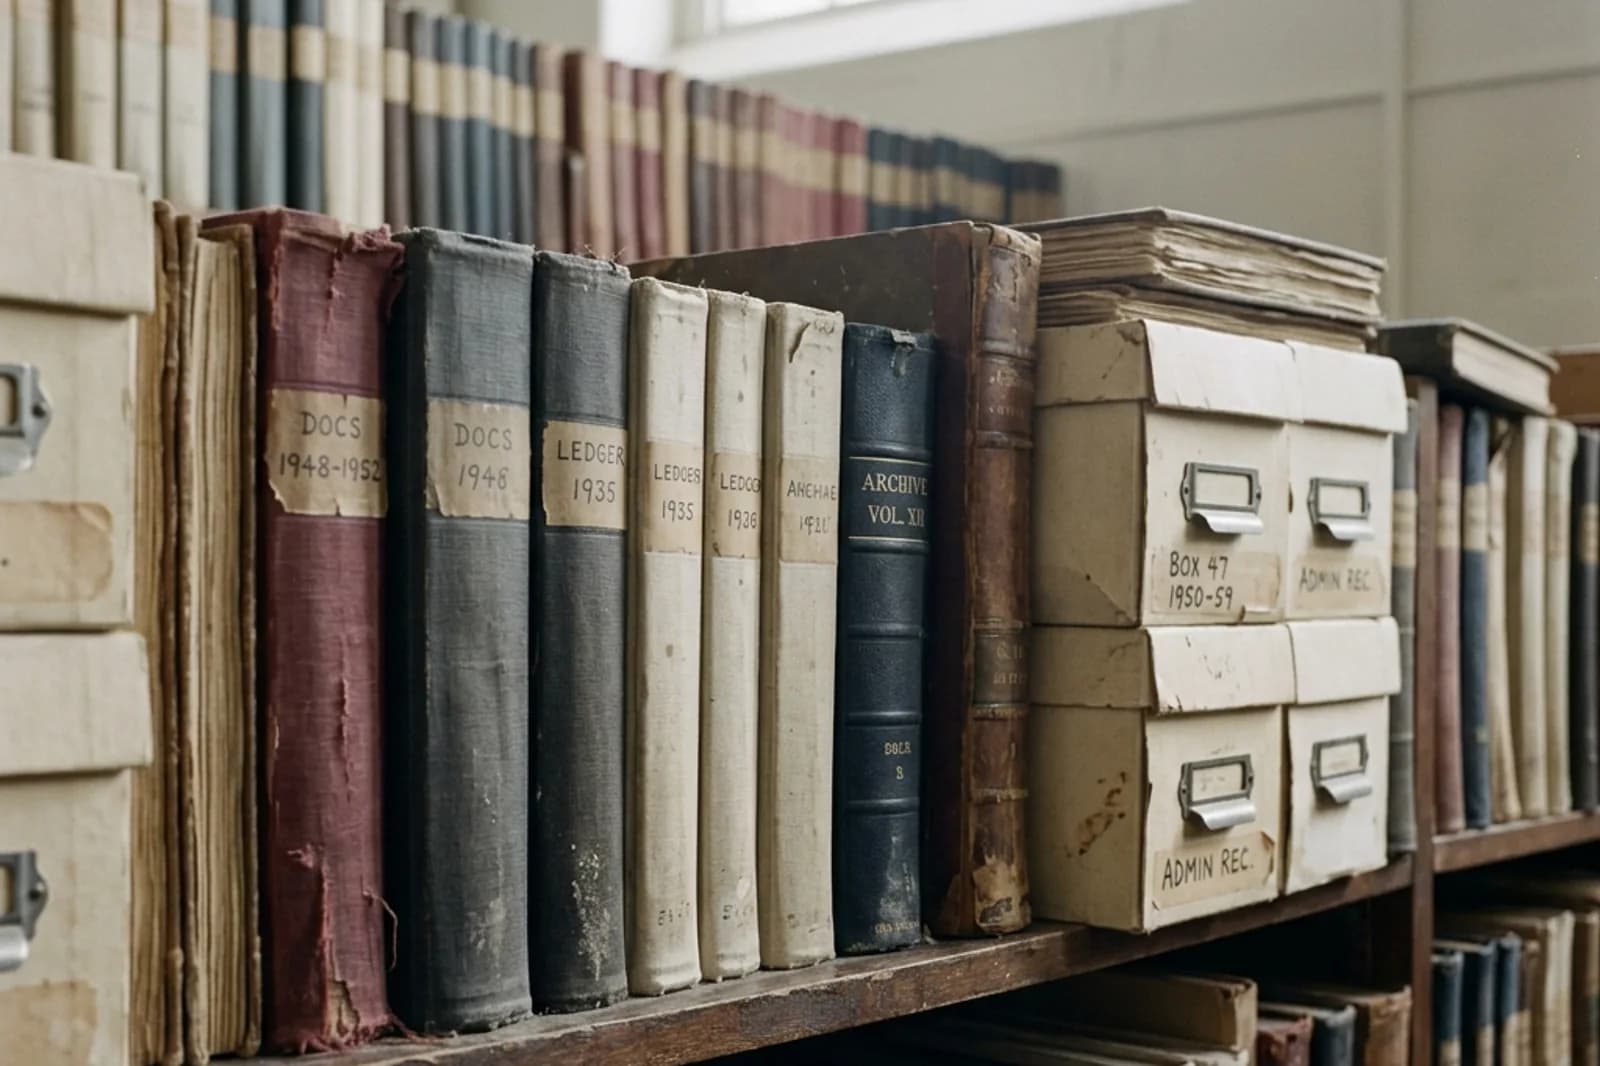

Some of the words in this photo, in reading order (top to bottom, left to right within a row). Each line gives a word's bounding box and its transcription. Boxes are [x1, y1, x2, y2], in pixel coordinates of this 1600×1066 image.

[301, 411, 362, 439] DOCS
[453, 422, 513, 450] DOCS
[557, 439, 625, 466] LEDGER
[279, 452, 382, 482] 1948-1952
[573, 477, 617, 504] 1935
[861, 472, 928, 496] ARCHIVE
[662, 499, 694, 523] 1935
[1169, 550, 1201, 577] BOX
[1207, 556, 1229, 580] 47
[1168, 584, 1233, 610] 1950-59
[1161, 853, 1214, 891] ADMIN
[1220, 847, 1254, 875] REC.
